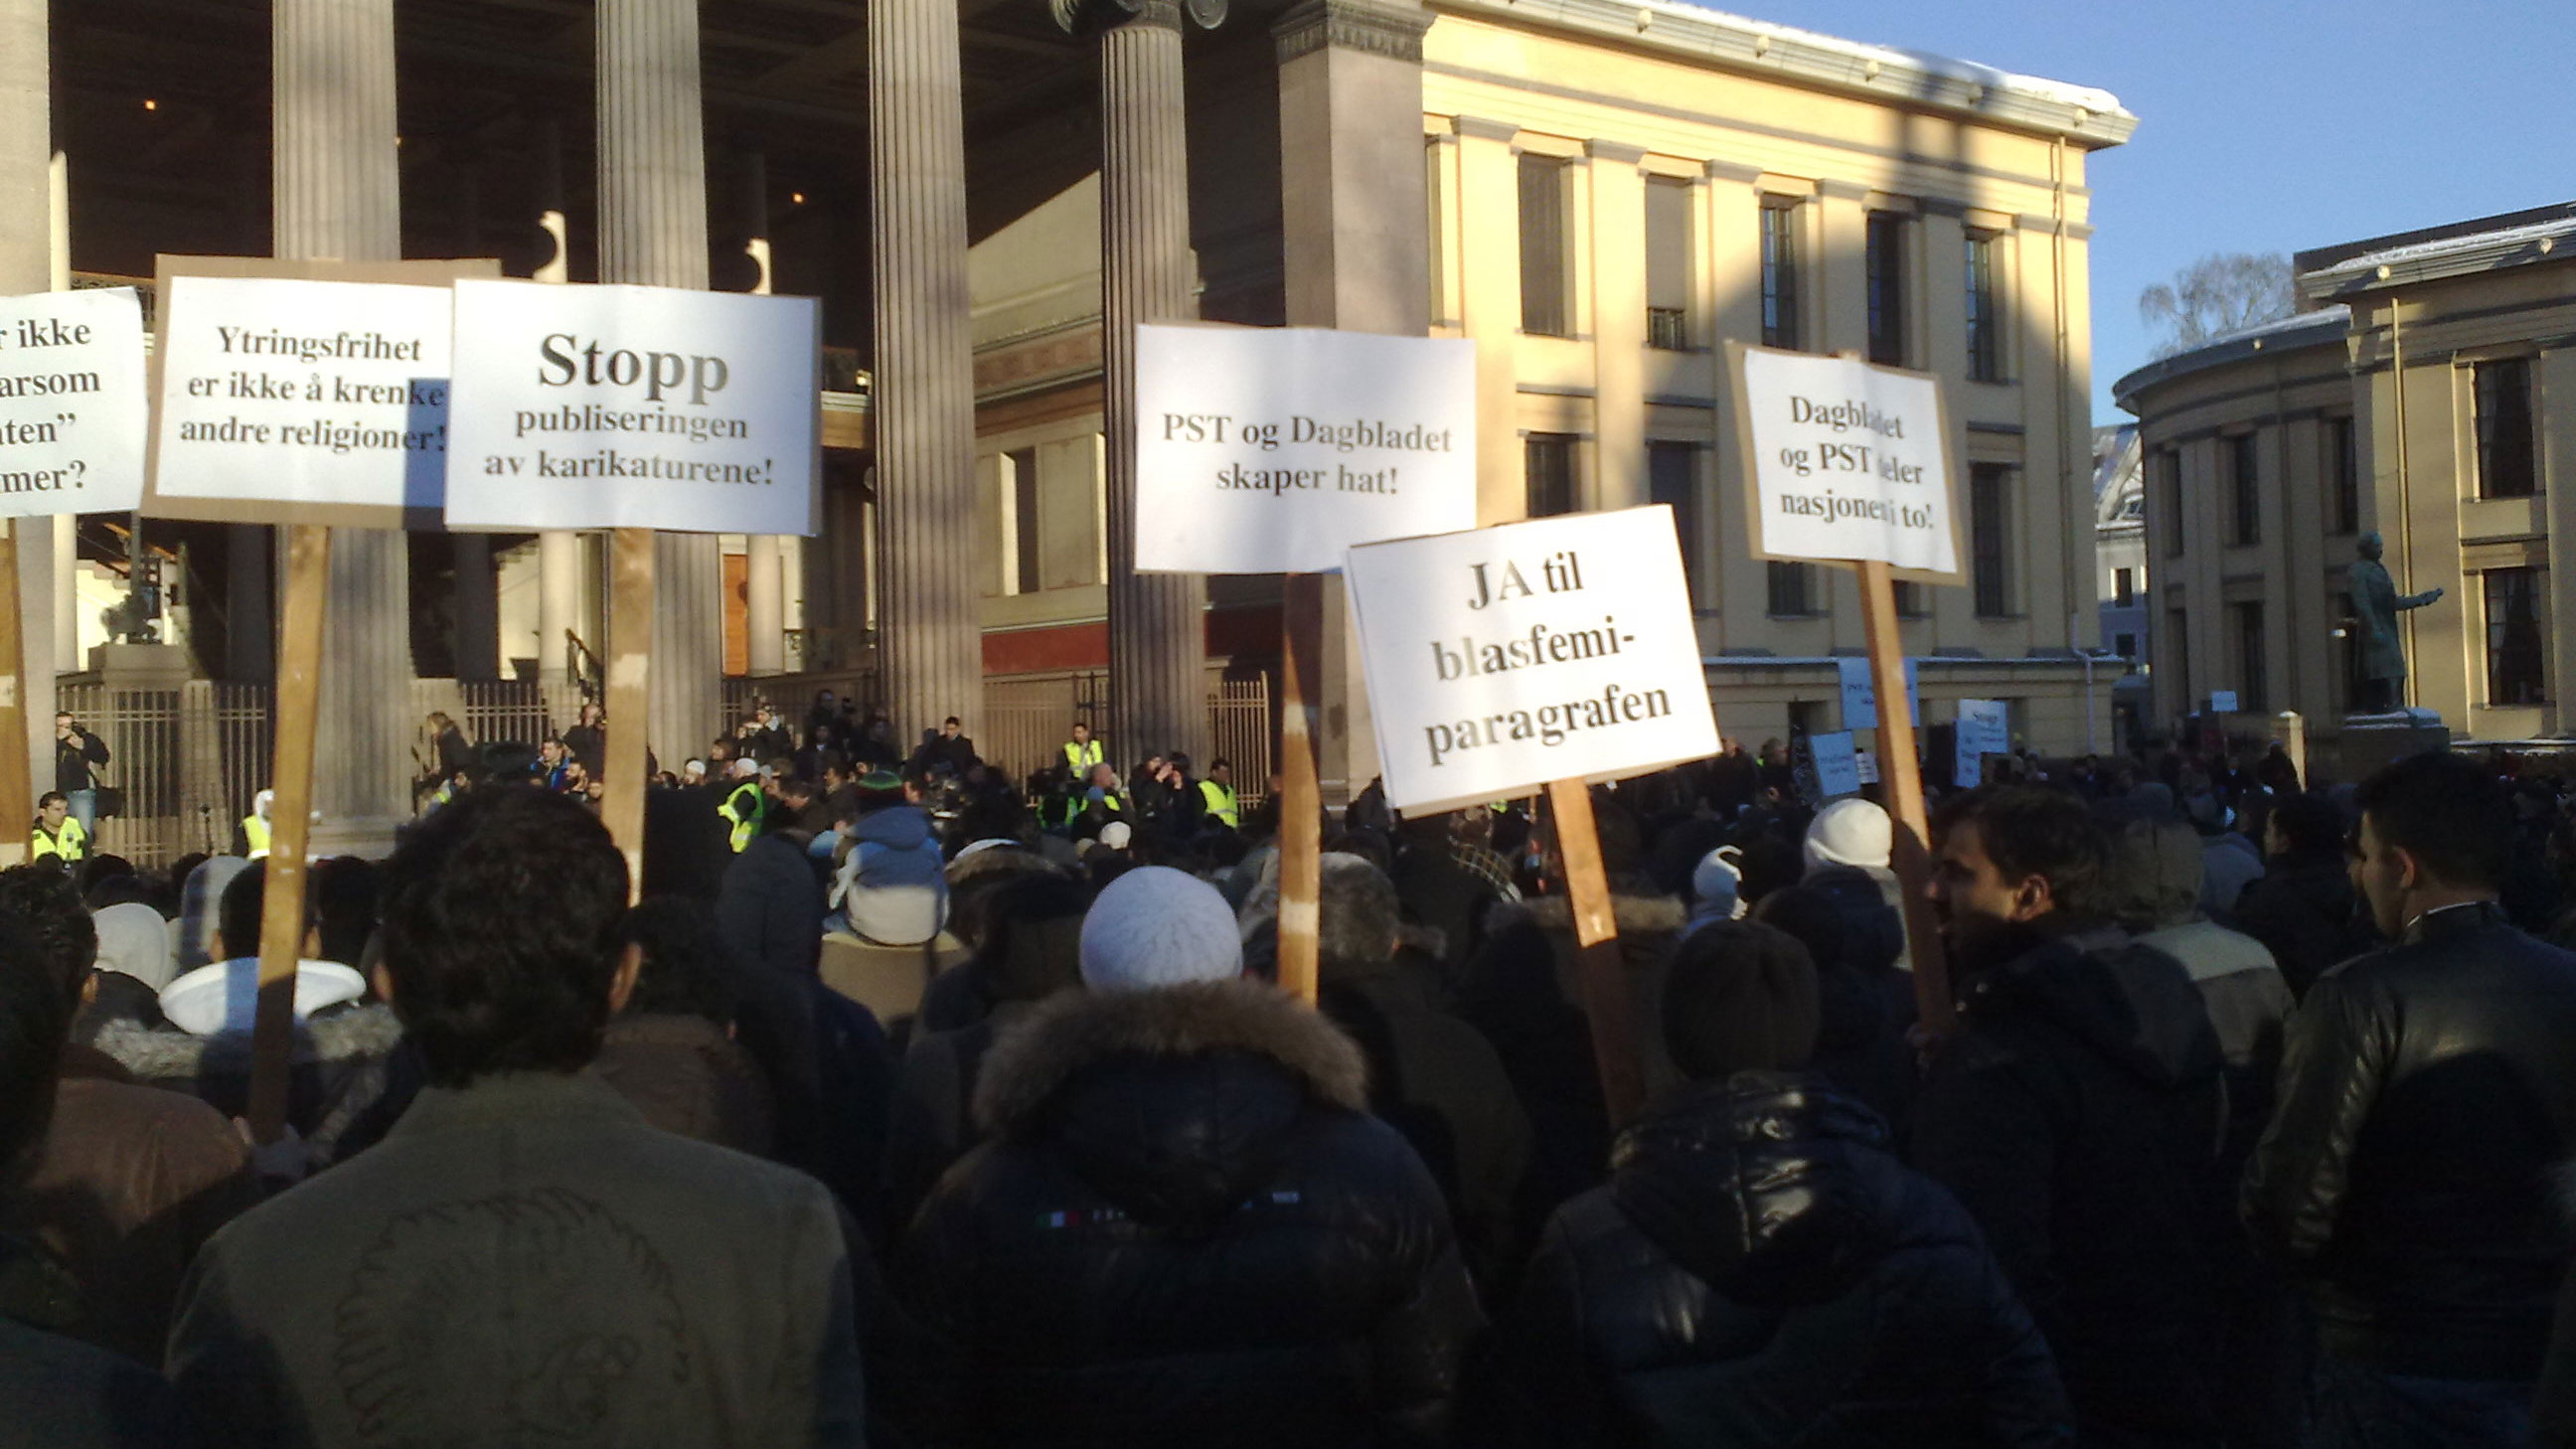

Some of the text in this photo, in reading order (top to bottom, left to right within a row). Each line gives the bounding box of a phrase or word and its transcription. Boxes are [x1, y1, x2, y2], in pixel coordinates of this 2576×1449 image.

[18, 317, 91, 348] ikke
[217, 326, 422, 362] Ytringsfrihet
[539, 332, 728, 405] Stopp
[189, 371, 445, 406] er ikke å krenke
[0, 411, 77, 445] ten”
[181, 416, 446, 453] andre religioner!
[515, 404, 748, 443] publiseringen
[1163, 413, 1452, 453] PST og Dagbladet
[484, 449, 773, 485] av karikaturene!
[1780, 448, 1813, 477] og
[1819, 443, 1871, 472] PST
[1215, 463, 1399, 497] skaper hat!
[1902, 504, 1935, 530] to!
[1468, 551, 1585, 610] JA til
[1431, 615, 1635, 681] blasfemi-
[1425, 685, 1672, 766] paragrafen
